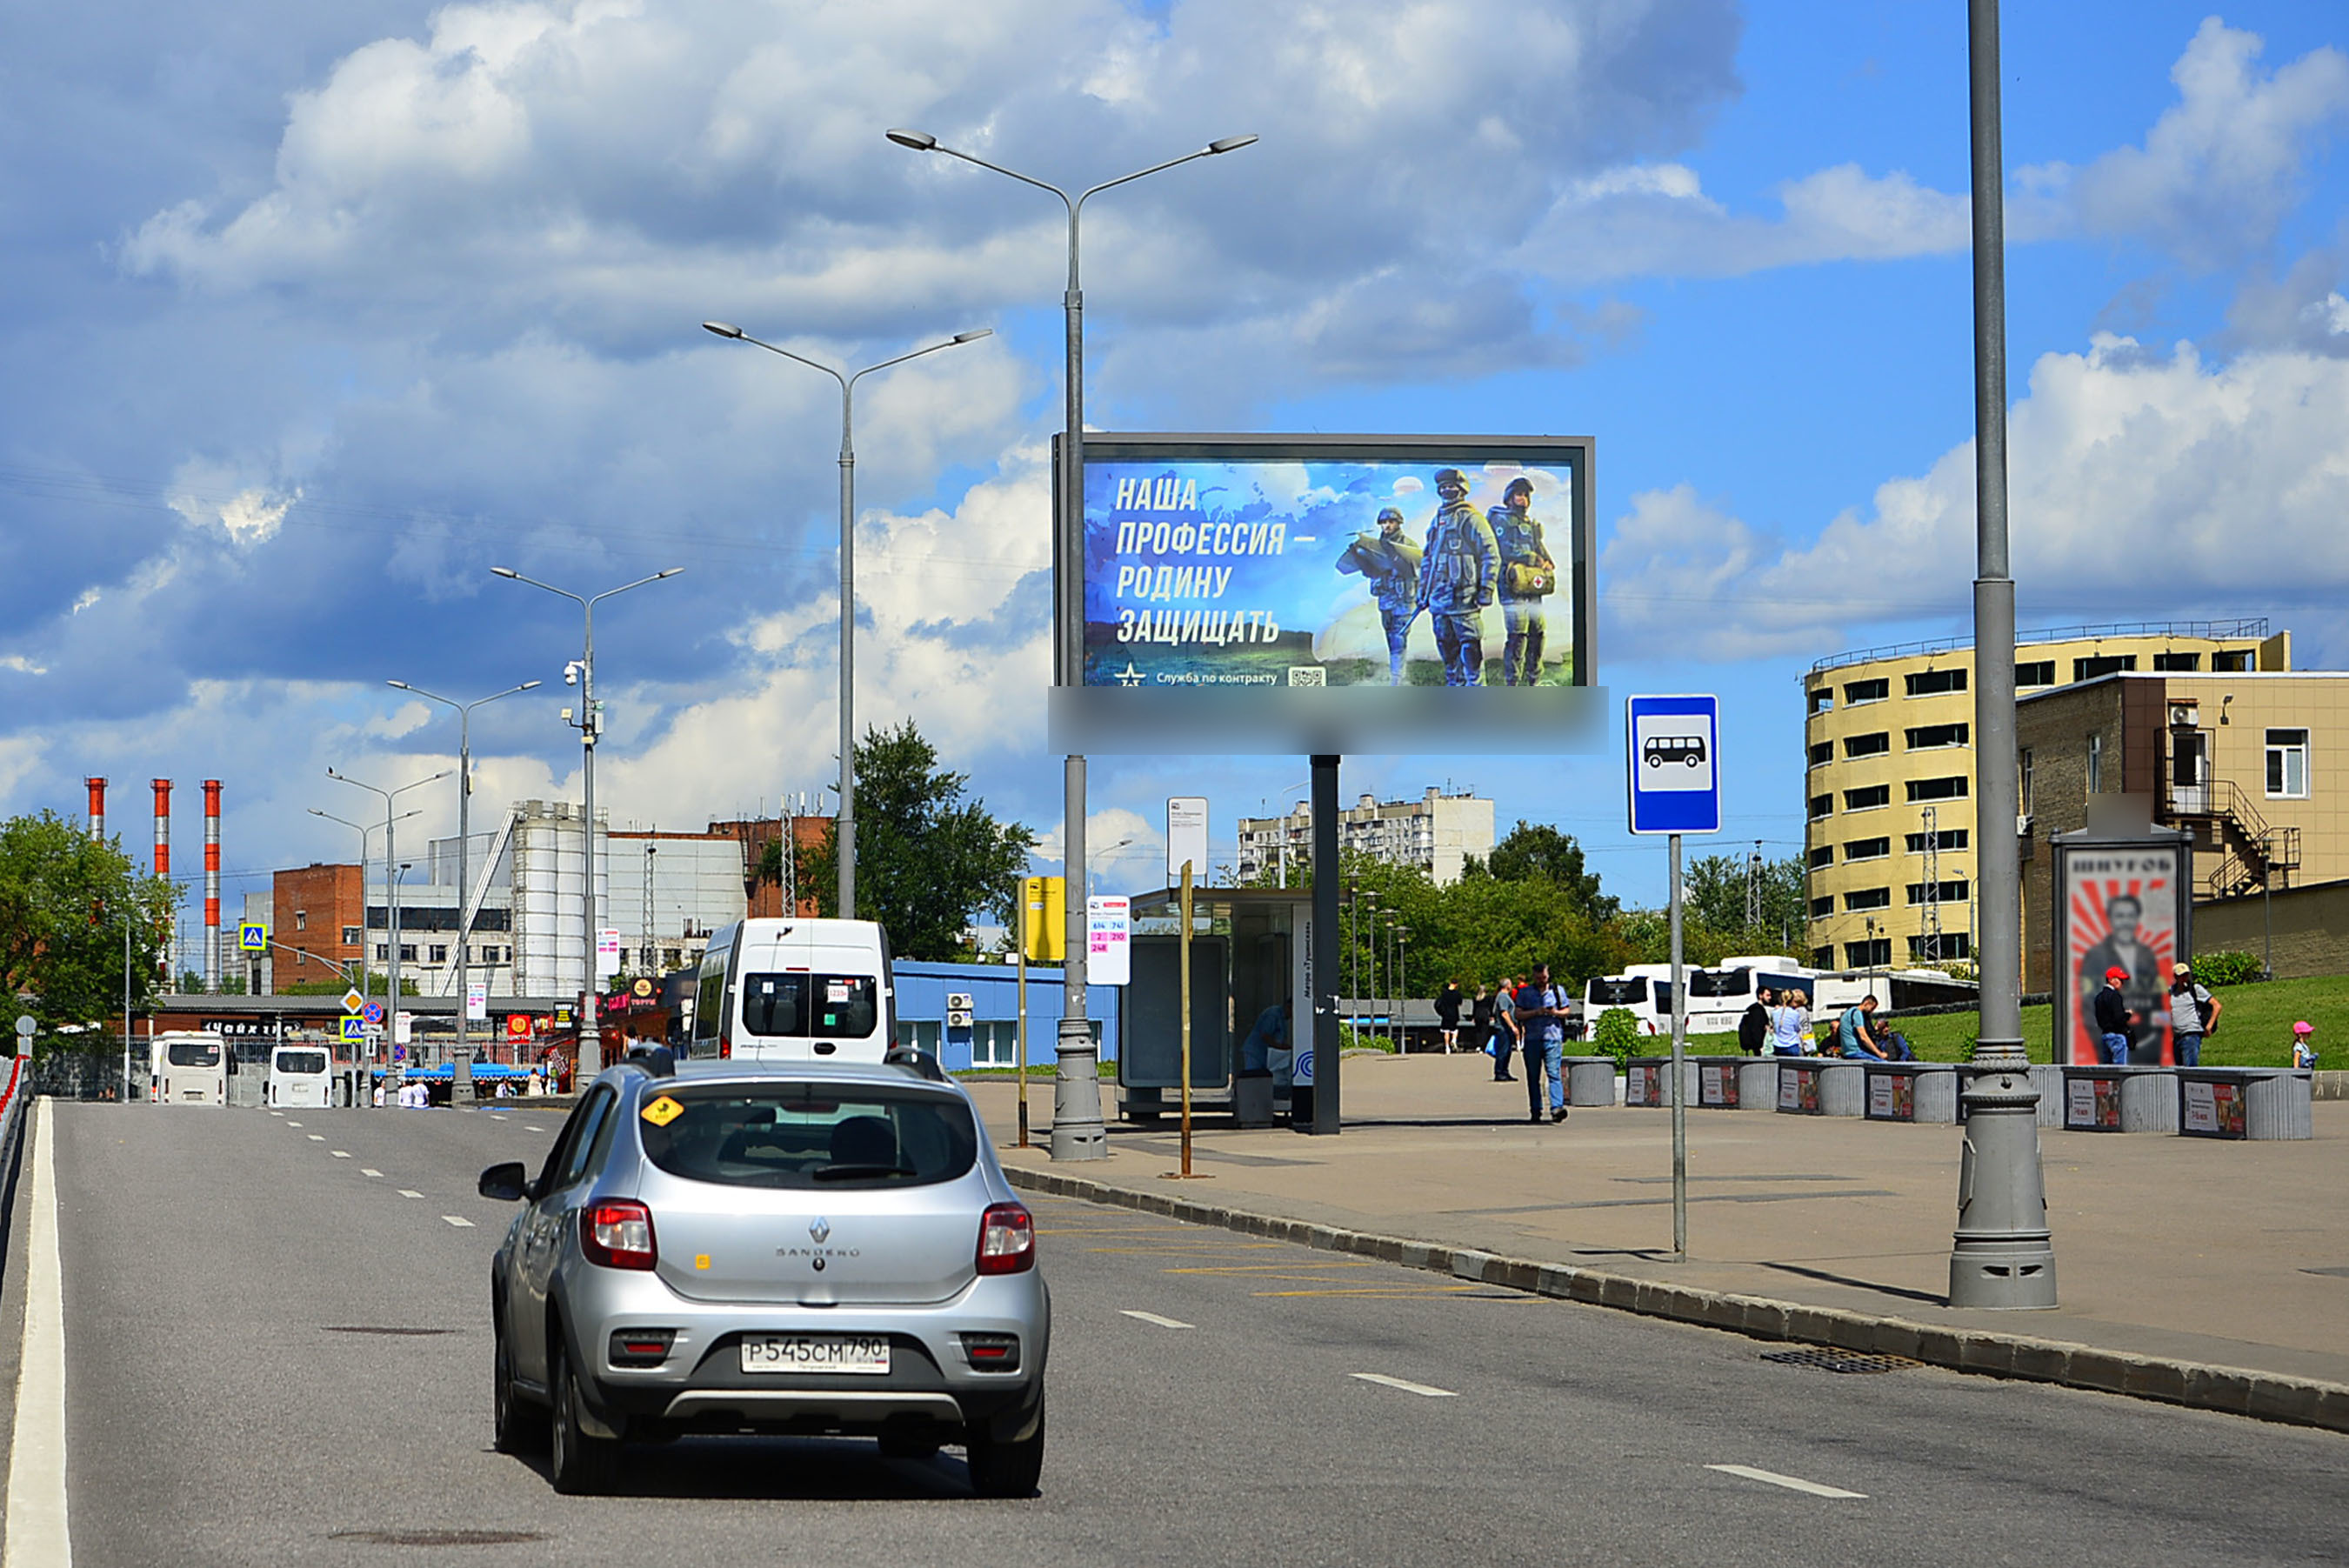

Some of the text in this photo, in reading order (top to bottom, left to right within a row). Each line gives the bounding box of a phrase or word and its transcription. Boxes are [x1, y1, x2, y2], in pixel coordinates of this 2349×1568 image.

[1116, 477, 1197, 511] НАША
[1116, 522, 1286, 556] ПРОФЕССИЯ
[1117, 566, 1232, 602] РОДИНУ
[1117, 610, 1279, 646] ЗАЩИЩАТЬ
[1157, 672, 1278, 686] Служба по контракту
[1304, 973, 1312, 999] Метро
[776, 1248, 861, 1258] SANDERO
[749, 1338, 883, 1363] Р545СМ 790
